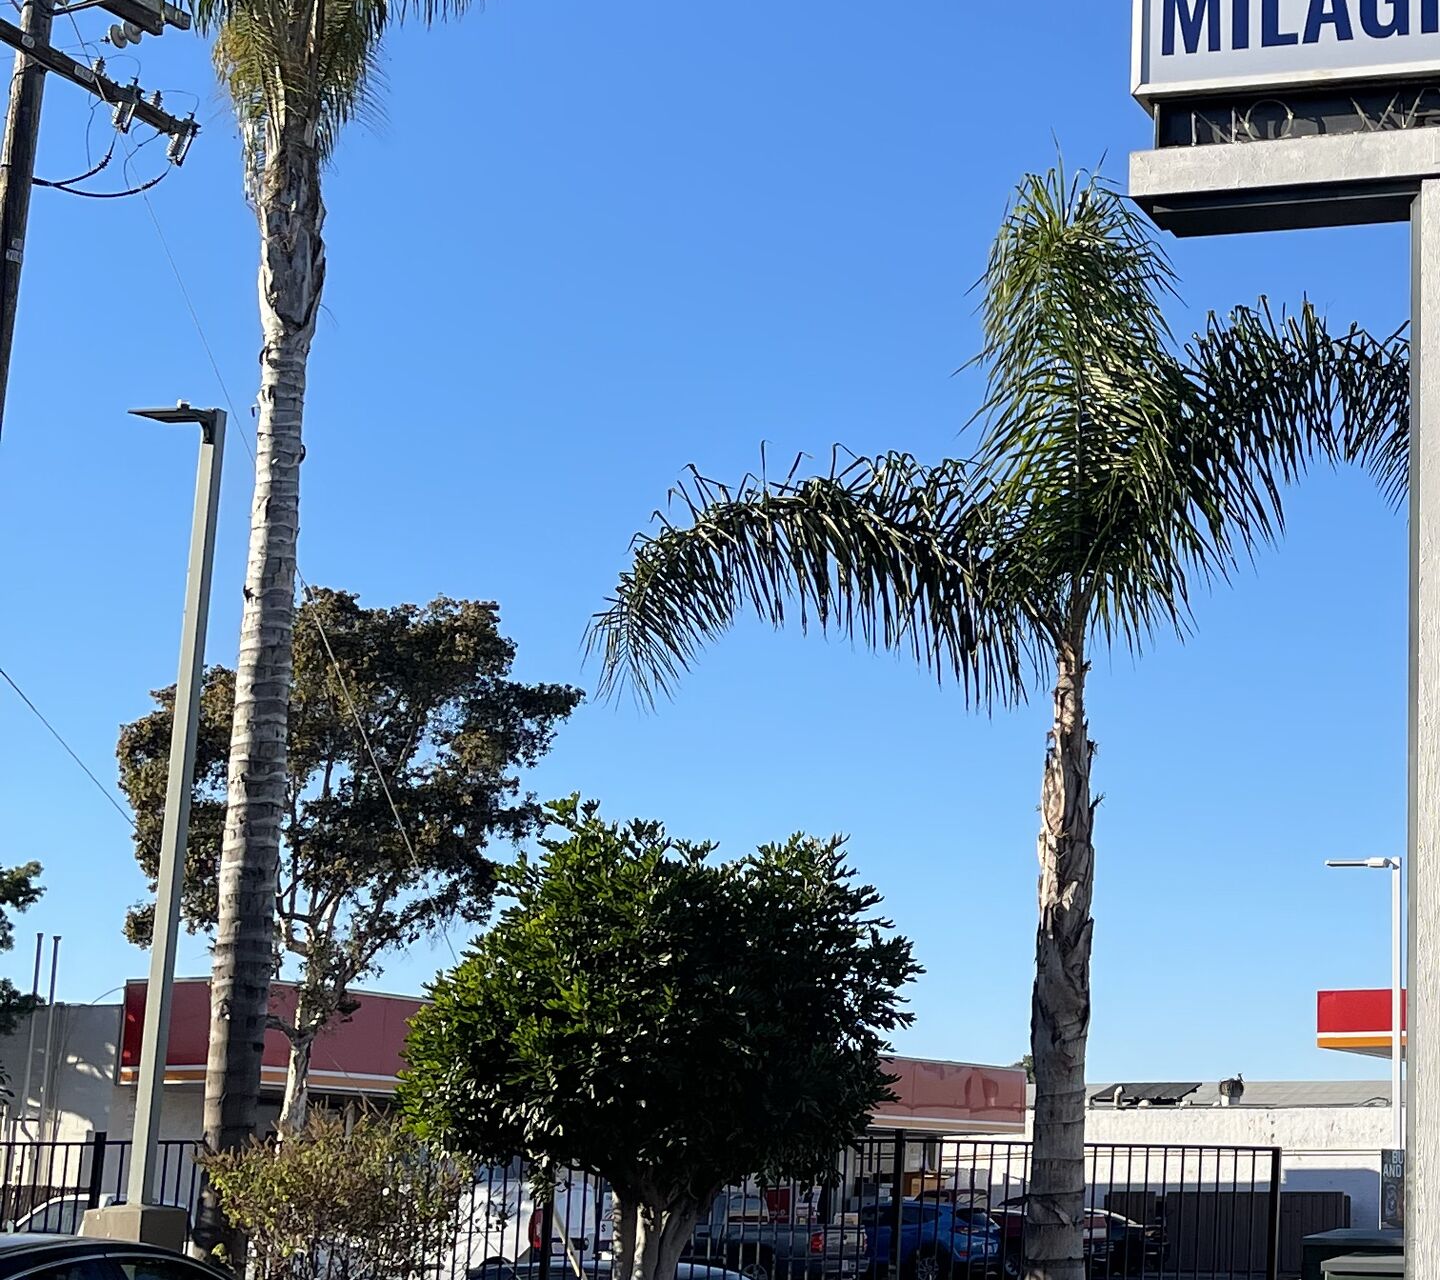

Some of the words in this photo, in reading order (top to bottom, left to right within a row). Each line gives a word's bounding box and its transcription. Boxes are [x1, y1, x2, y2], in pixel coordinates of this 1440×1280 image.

[1191, 98, 1294, 147] NO
[1392, 1150, 1404, 1165] BU
[1383, 1164, 1402, 1177] AND
